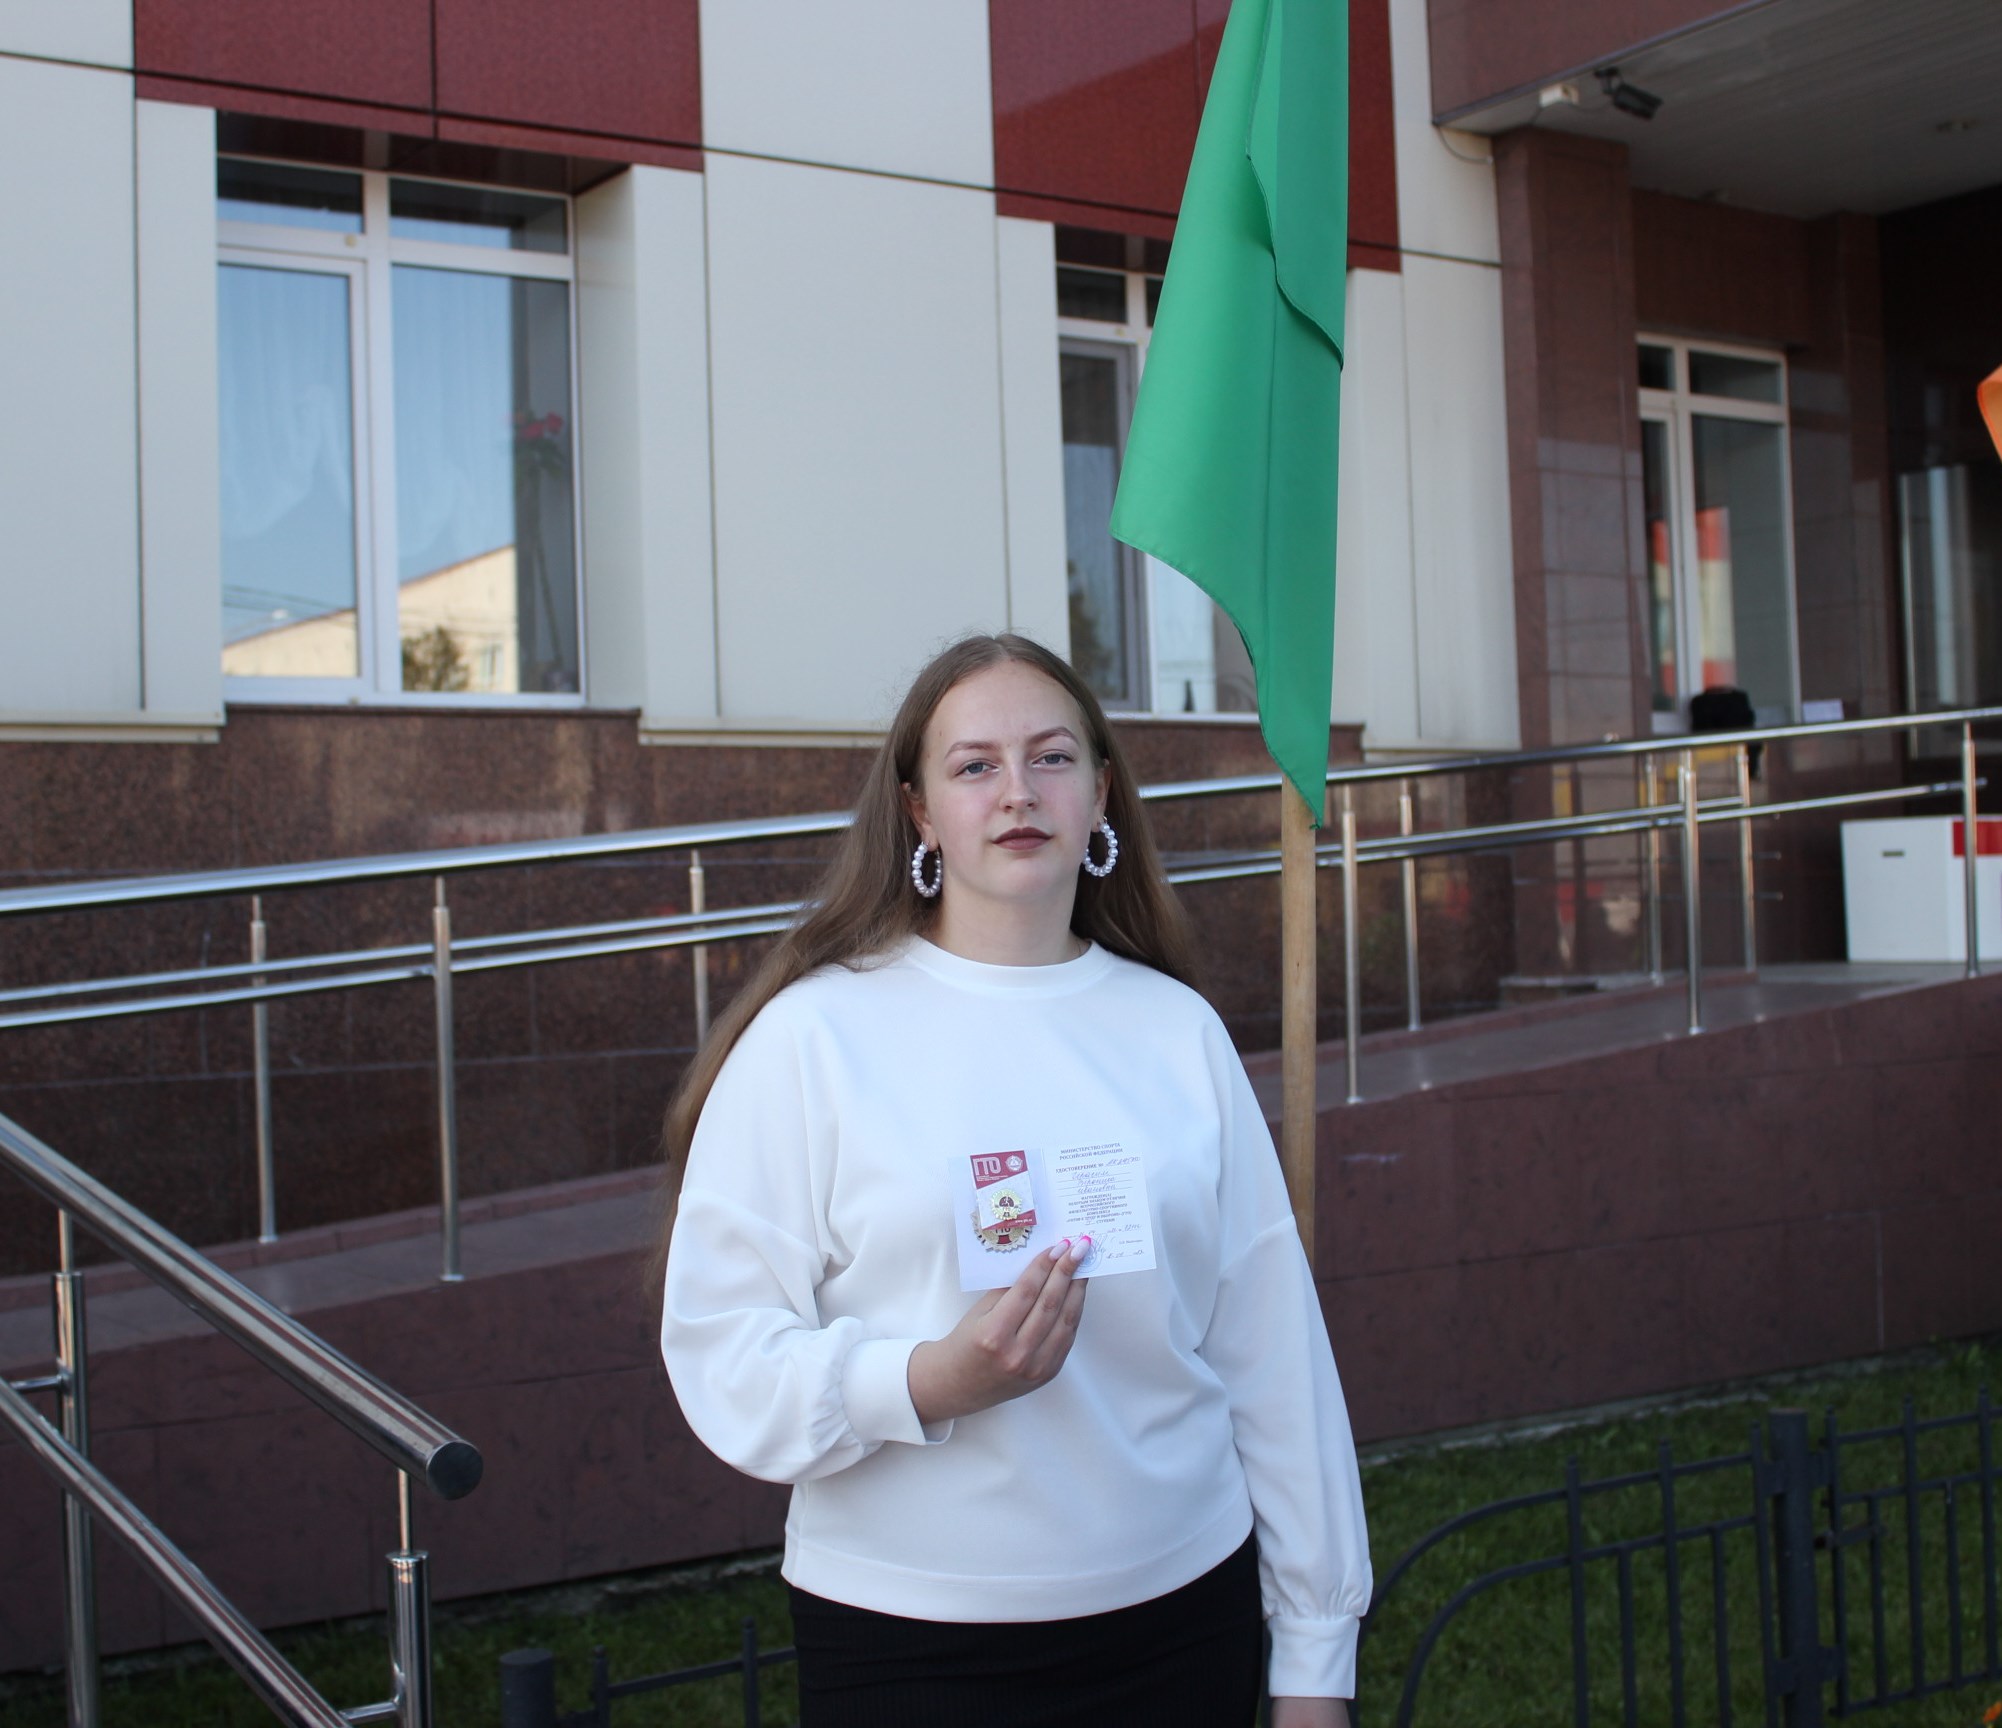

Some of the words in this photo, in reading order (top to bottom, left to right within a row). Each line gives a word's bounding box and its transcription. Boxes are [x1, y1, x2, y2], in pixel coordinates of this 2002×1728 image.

[1059, 1151, 1093, 1161] РОССИЙСКОЙ
[1093, 1148, 1123, 1156] ФЕДЕРАЦИИ
[1060, 1145, 1101, 1154] МИНИСТЕРСТВО
[973, 1157, 1001, 1175] ГТО
[1056, 1164, 1097, 1173] УДОСТОВЕРЕНИЕ
